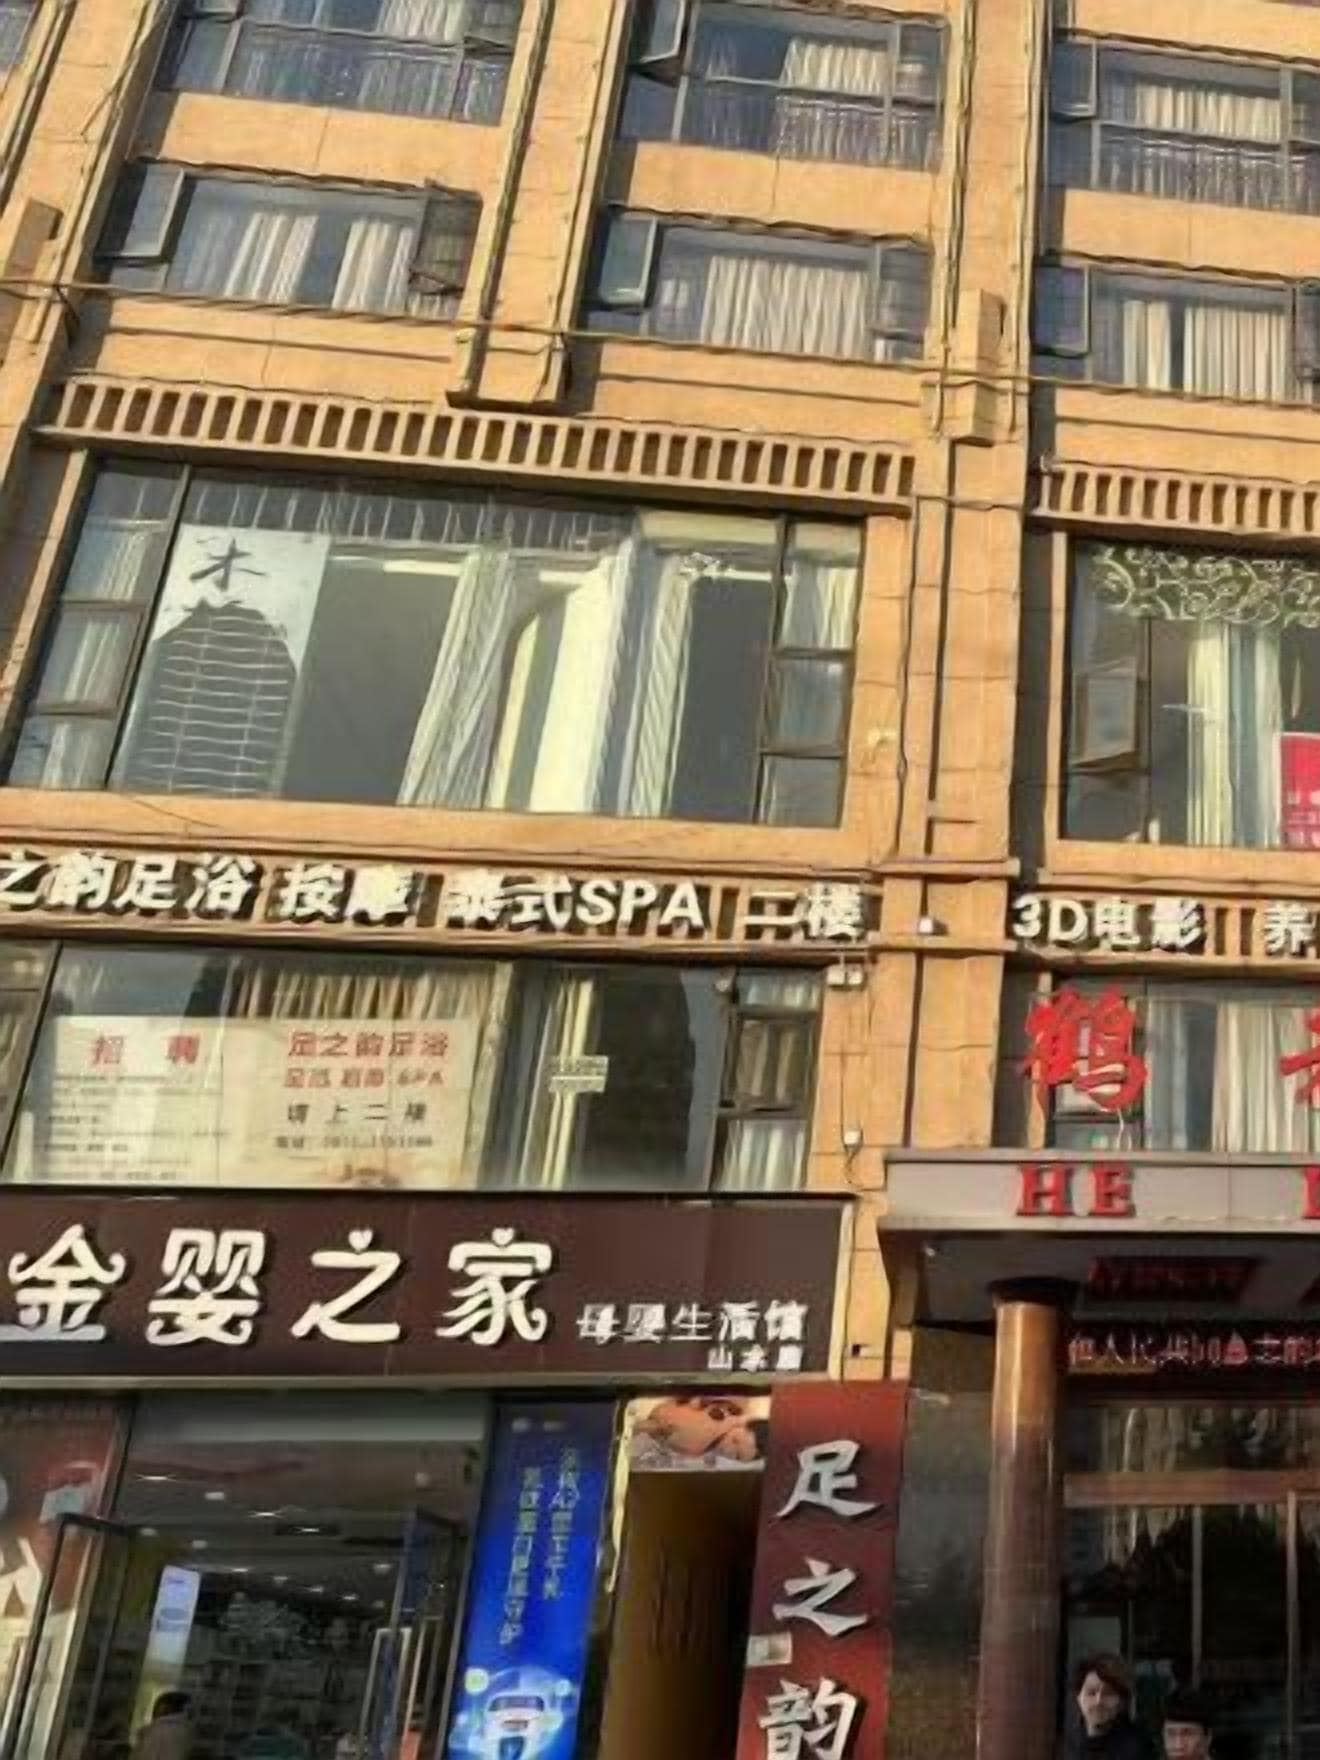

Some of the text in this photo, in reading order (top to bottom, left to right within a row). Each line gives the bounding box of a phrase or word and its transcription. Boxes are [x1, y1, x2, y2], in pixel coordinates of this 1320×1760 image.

[1012, 894, 1206, 949] 3D电影
[1017, 1161, 1137, 1218] HE
[2, 1223, 554, 1348] 金婴之家
[759, 1439, 880, 1760] 足之韵
